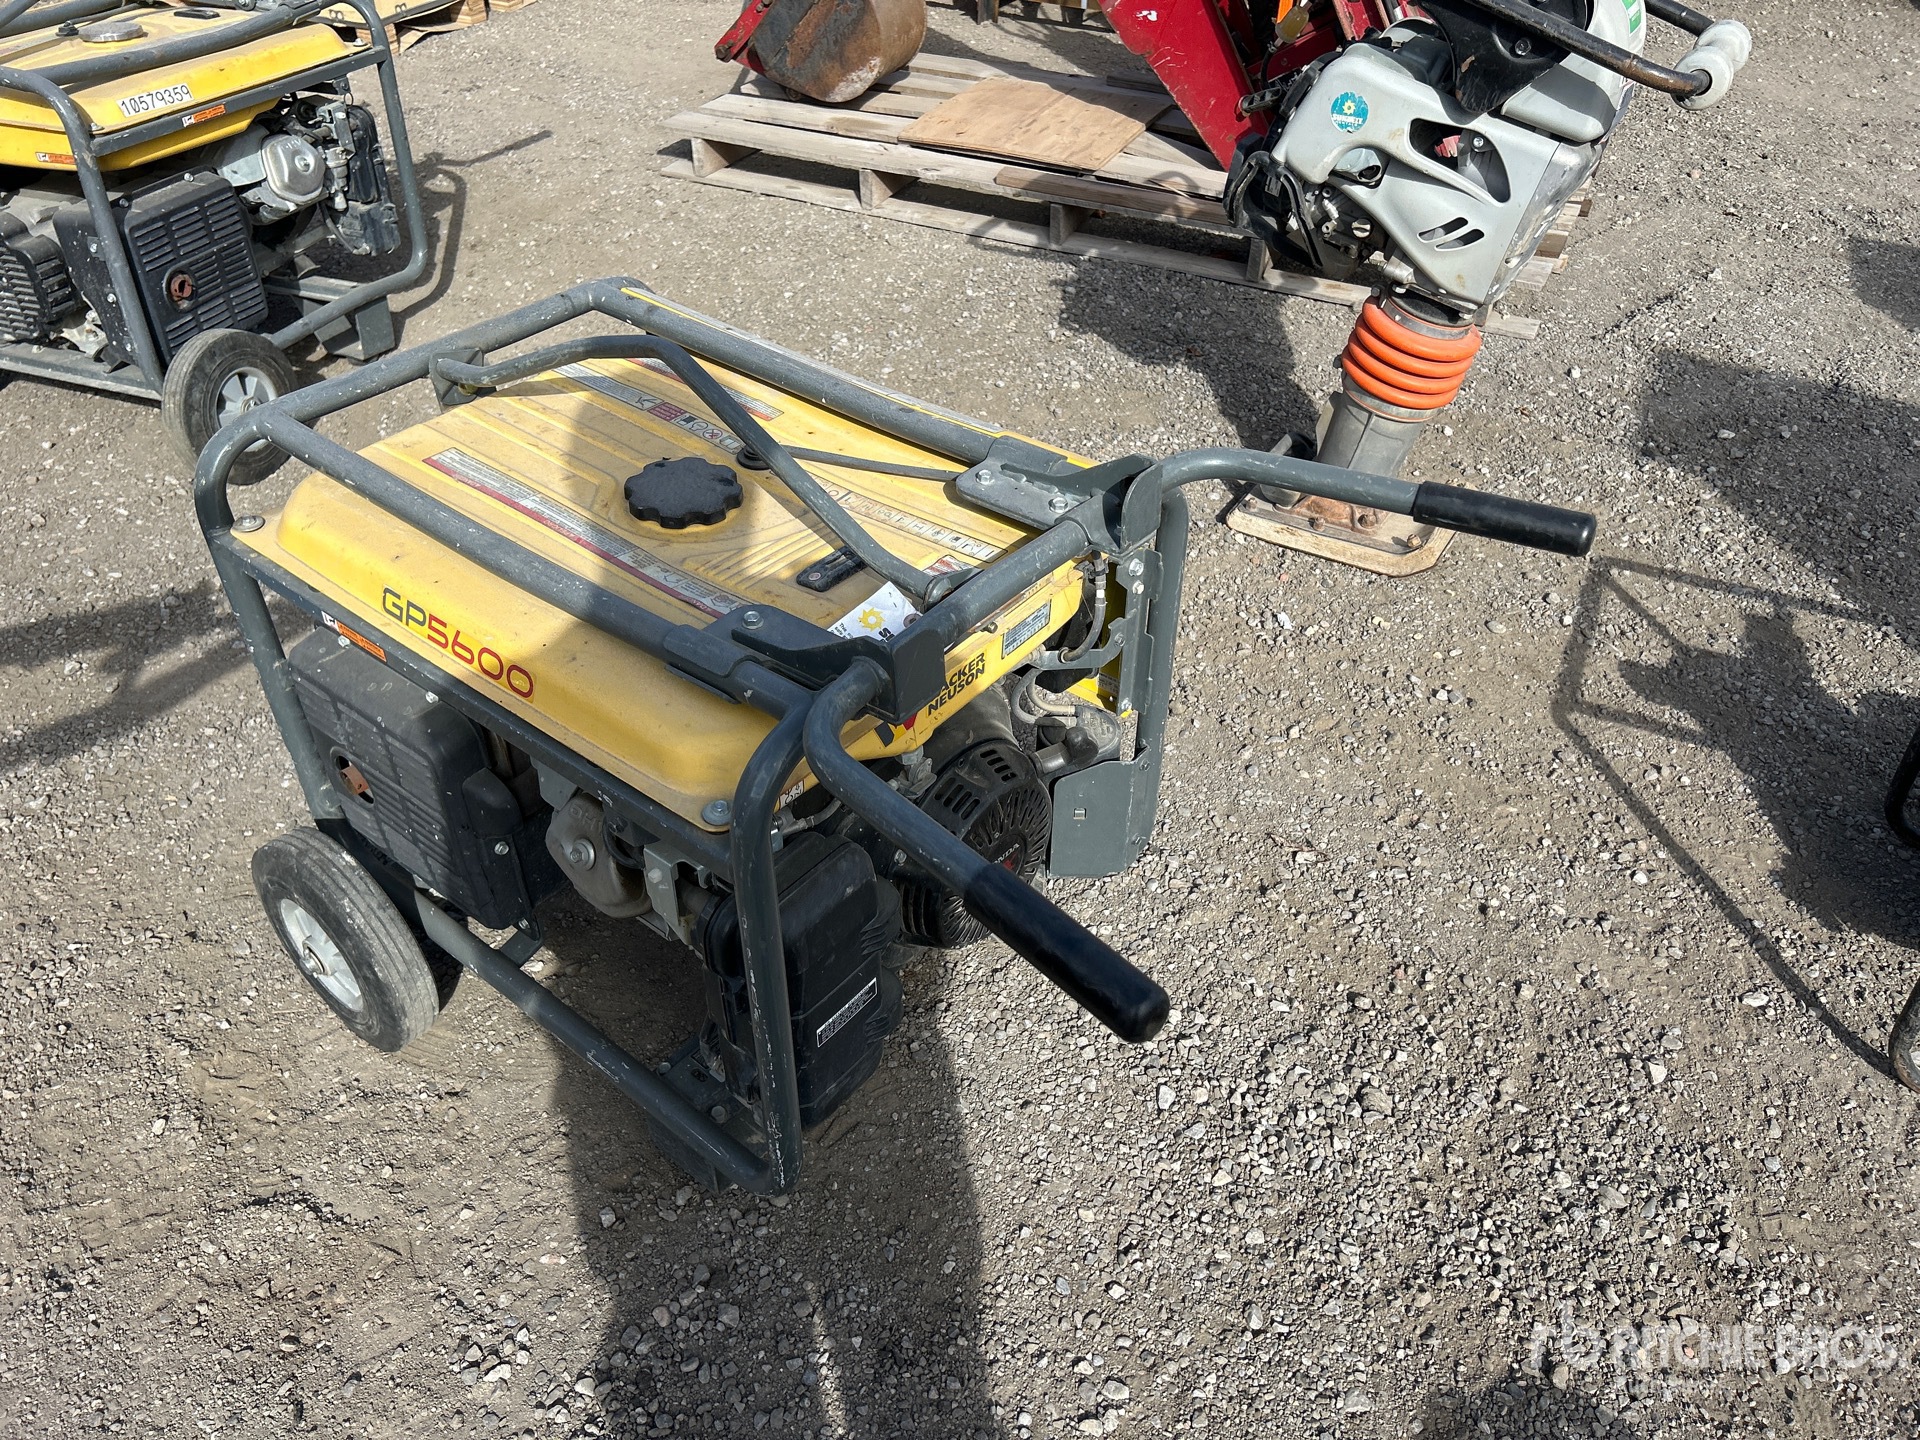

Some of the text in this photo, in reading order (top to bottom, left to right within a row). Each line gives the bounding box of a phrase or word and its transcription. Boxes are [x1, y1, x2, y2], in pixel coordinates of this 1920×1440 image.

[120, 84, 192, 116] 10579359
[382, 587, 534, 699] GP5600
[927, 663, 986, 716] NEUSON
[939, 652, 986, 693] ACKER
